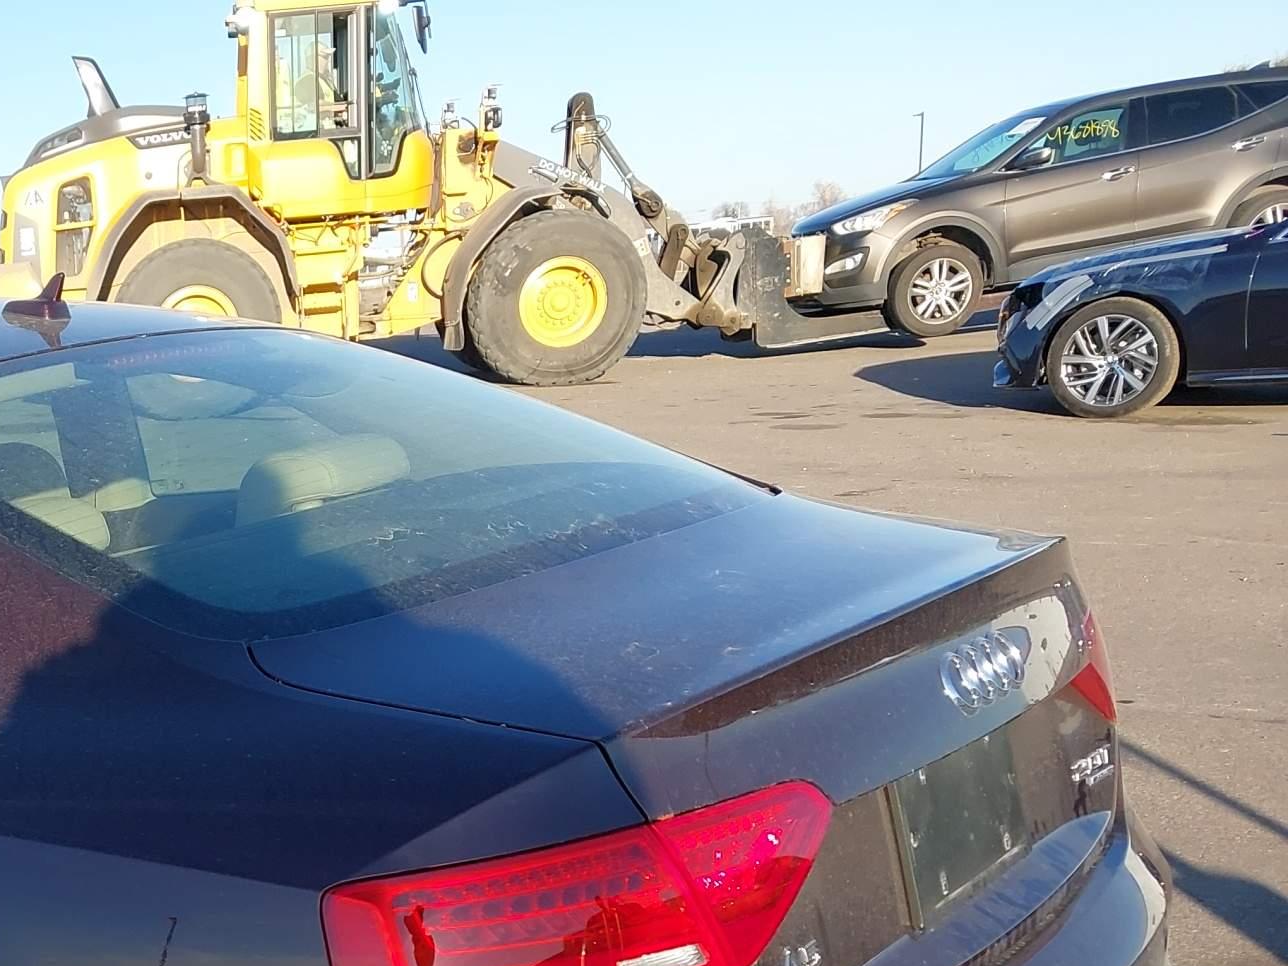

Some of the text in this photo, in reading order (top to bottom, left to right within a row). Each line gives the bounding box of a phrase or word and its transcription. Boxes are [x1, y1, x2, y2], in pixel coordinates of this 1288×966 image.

[539, 159, 607, 194] DO NOT WALK
